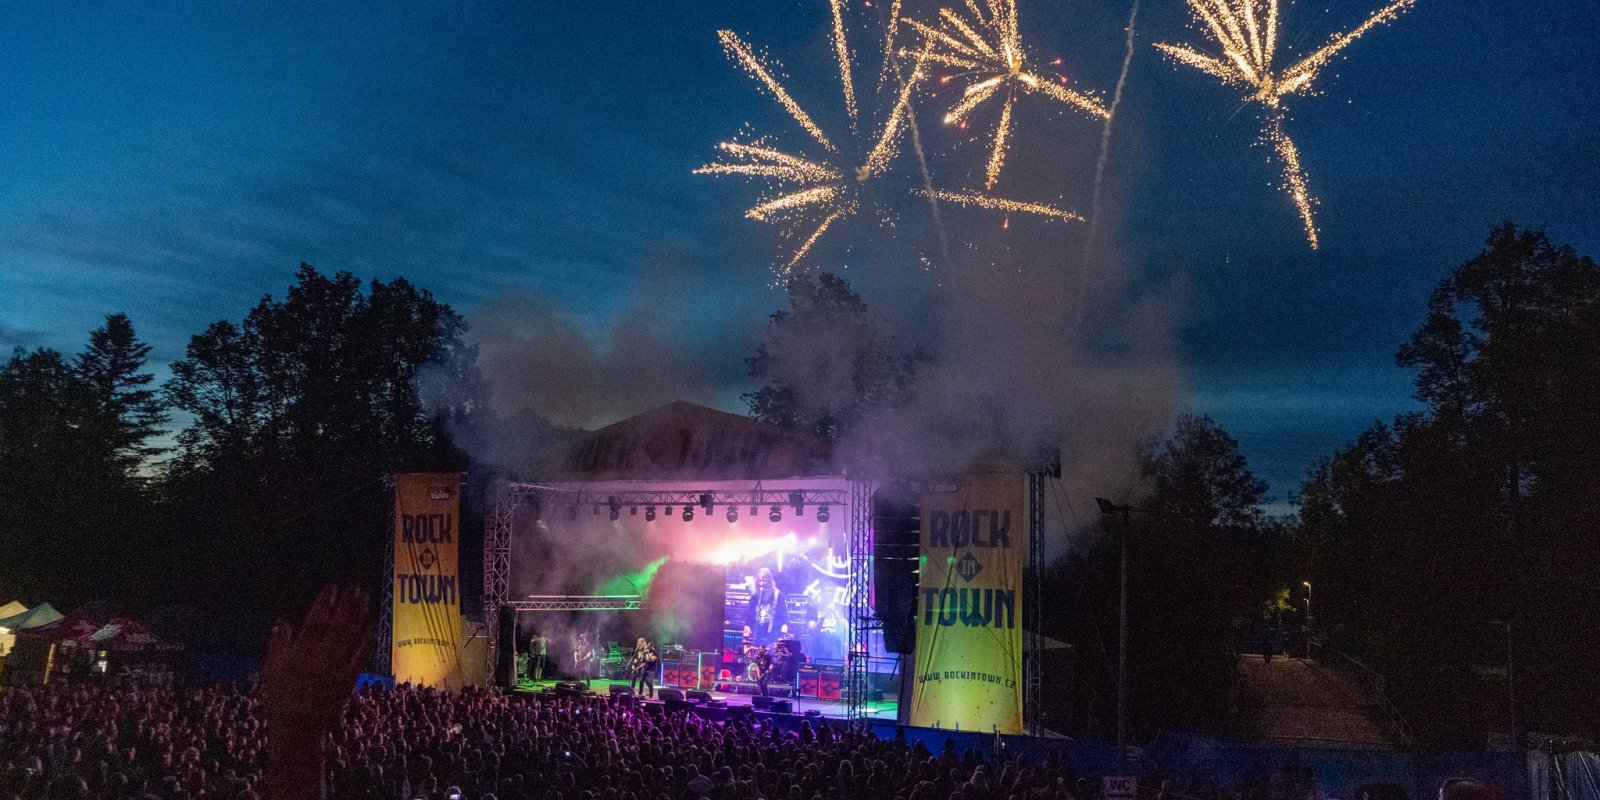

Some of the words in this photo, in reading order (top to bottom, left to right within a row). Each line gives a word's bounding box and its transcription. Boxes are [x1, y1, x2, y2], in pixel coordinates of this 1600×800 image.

[402, 513, 452, 543] ROCK
[929, 510, 1010, 548] ROCK
[961, 560, 976, 574] IN
[398, 574, 456, 605] TOWN
[920, 587, 1015, 629] TOWN
[918, 670, 1017, 689] WWW.ROCKINTOWN.CZ
[1109, 779, 1131, 791] WC
